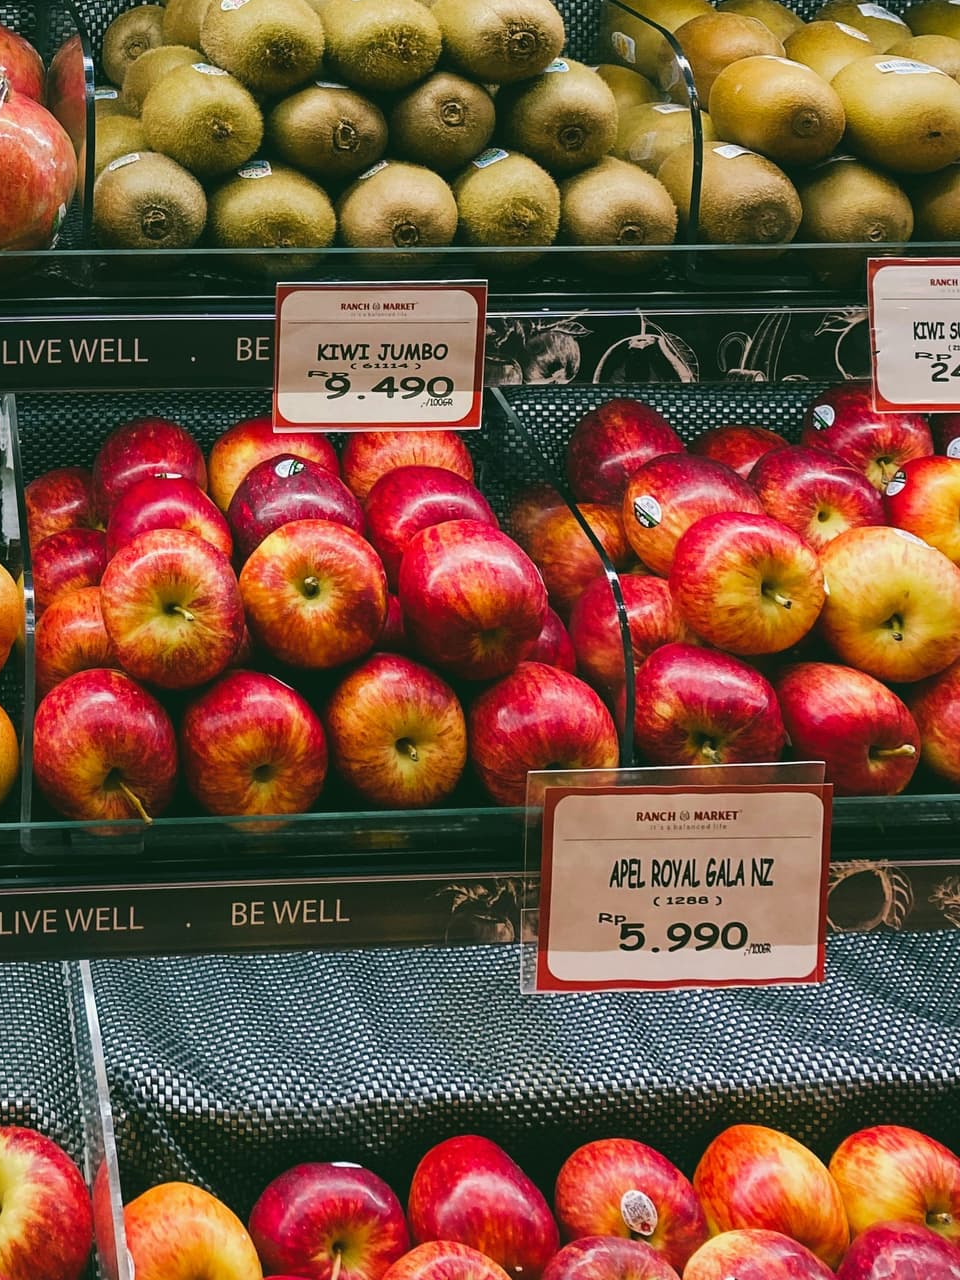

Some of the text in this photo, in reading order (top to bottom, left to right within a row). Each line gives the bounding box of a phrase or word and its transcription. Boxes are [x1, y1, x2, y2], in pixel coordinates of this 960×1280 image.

[930, 278, 958, 286] RANCH
[341, 303, 416, 311] RANCH MARKET
[913, 322, 945, 340] KIWI
[2, 337, 271, 365] LIVE WELL BE
[317, 343, 449, 361] KIWI JUMBO
[915, 352, 952, 361] Rp
[325, 376, 454, 400] 9.490
[636, 811, 739, 821] RANCH MARKET
[609, 858, 774, 889] APEL ROYAL GALA NZ
[65, 907, 144, 932] WELL
[231, 902, 265, 926] BE
[272, 899, 350, 924] WELL
[598, 912, 626, 926] Rp
[619, 921, 749, 953] 5.990
